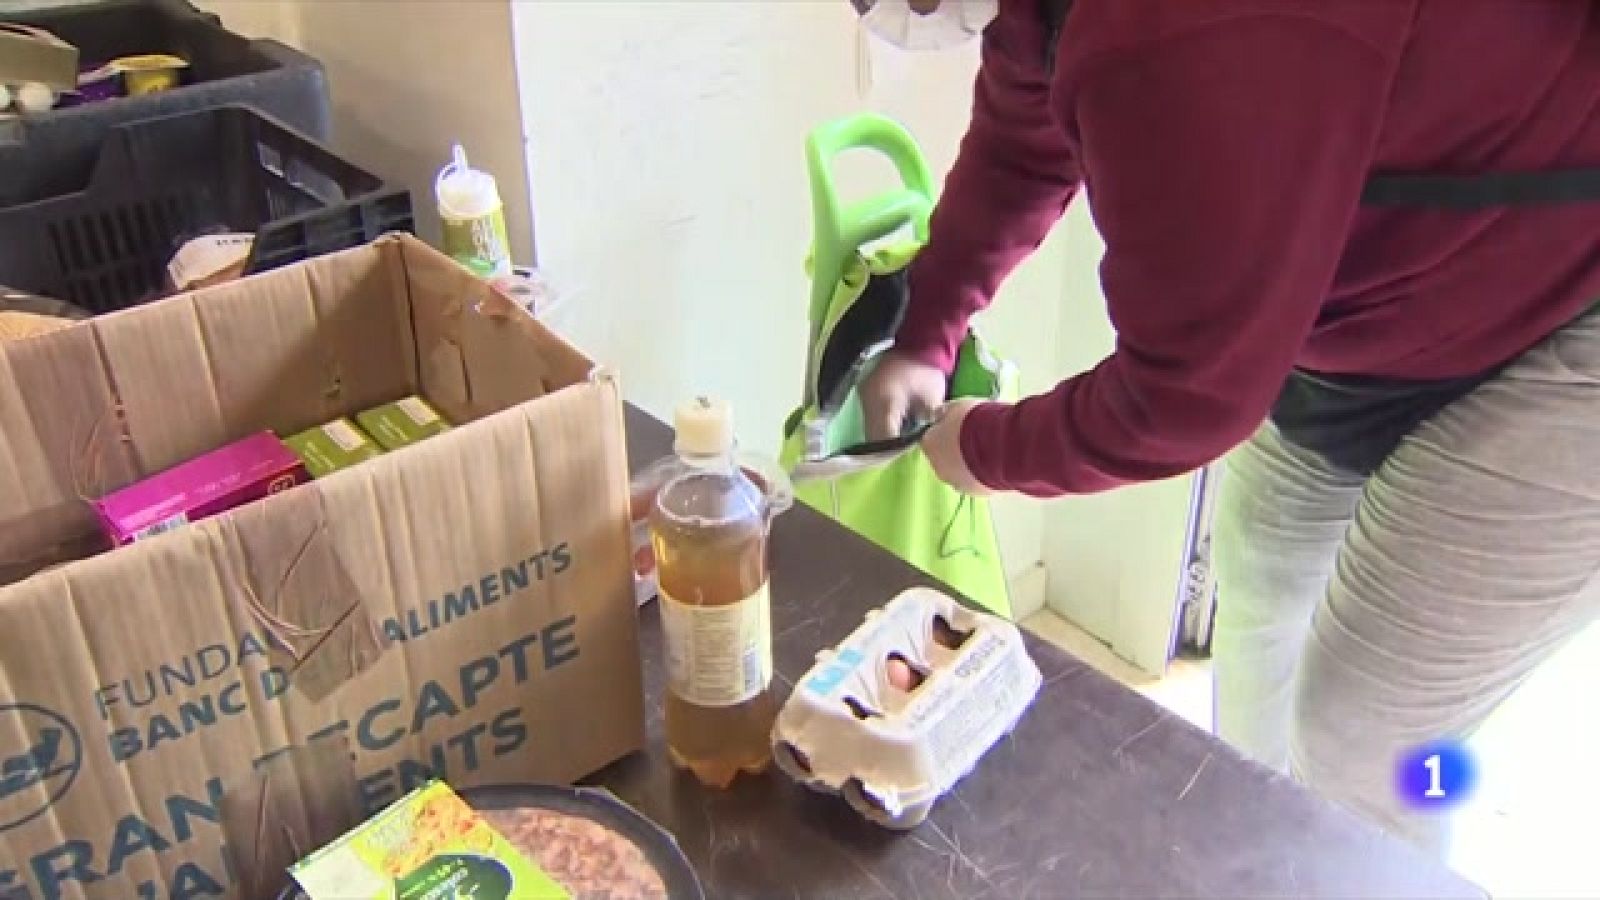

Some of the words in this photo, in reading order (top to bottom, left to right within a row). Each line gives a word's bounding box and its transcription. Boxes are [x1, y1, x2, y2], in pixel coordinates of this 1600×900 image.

[95, 632, 267, 720] FUNDA
[109, 681, 246, 760] BANC
[378, 542, 571, 643] ALIMENTS
